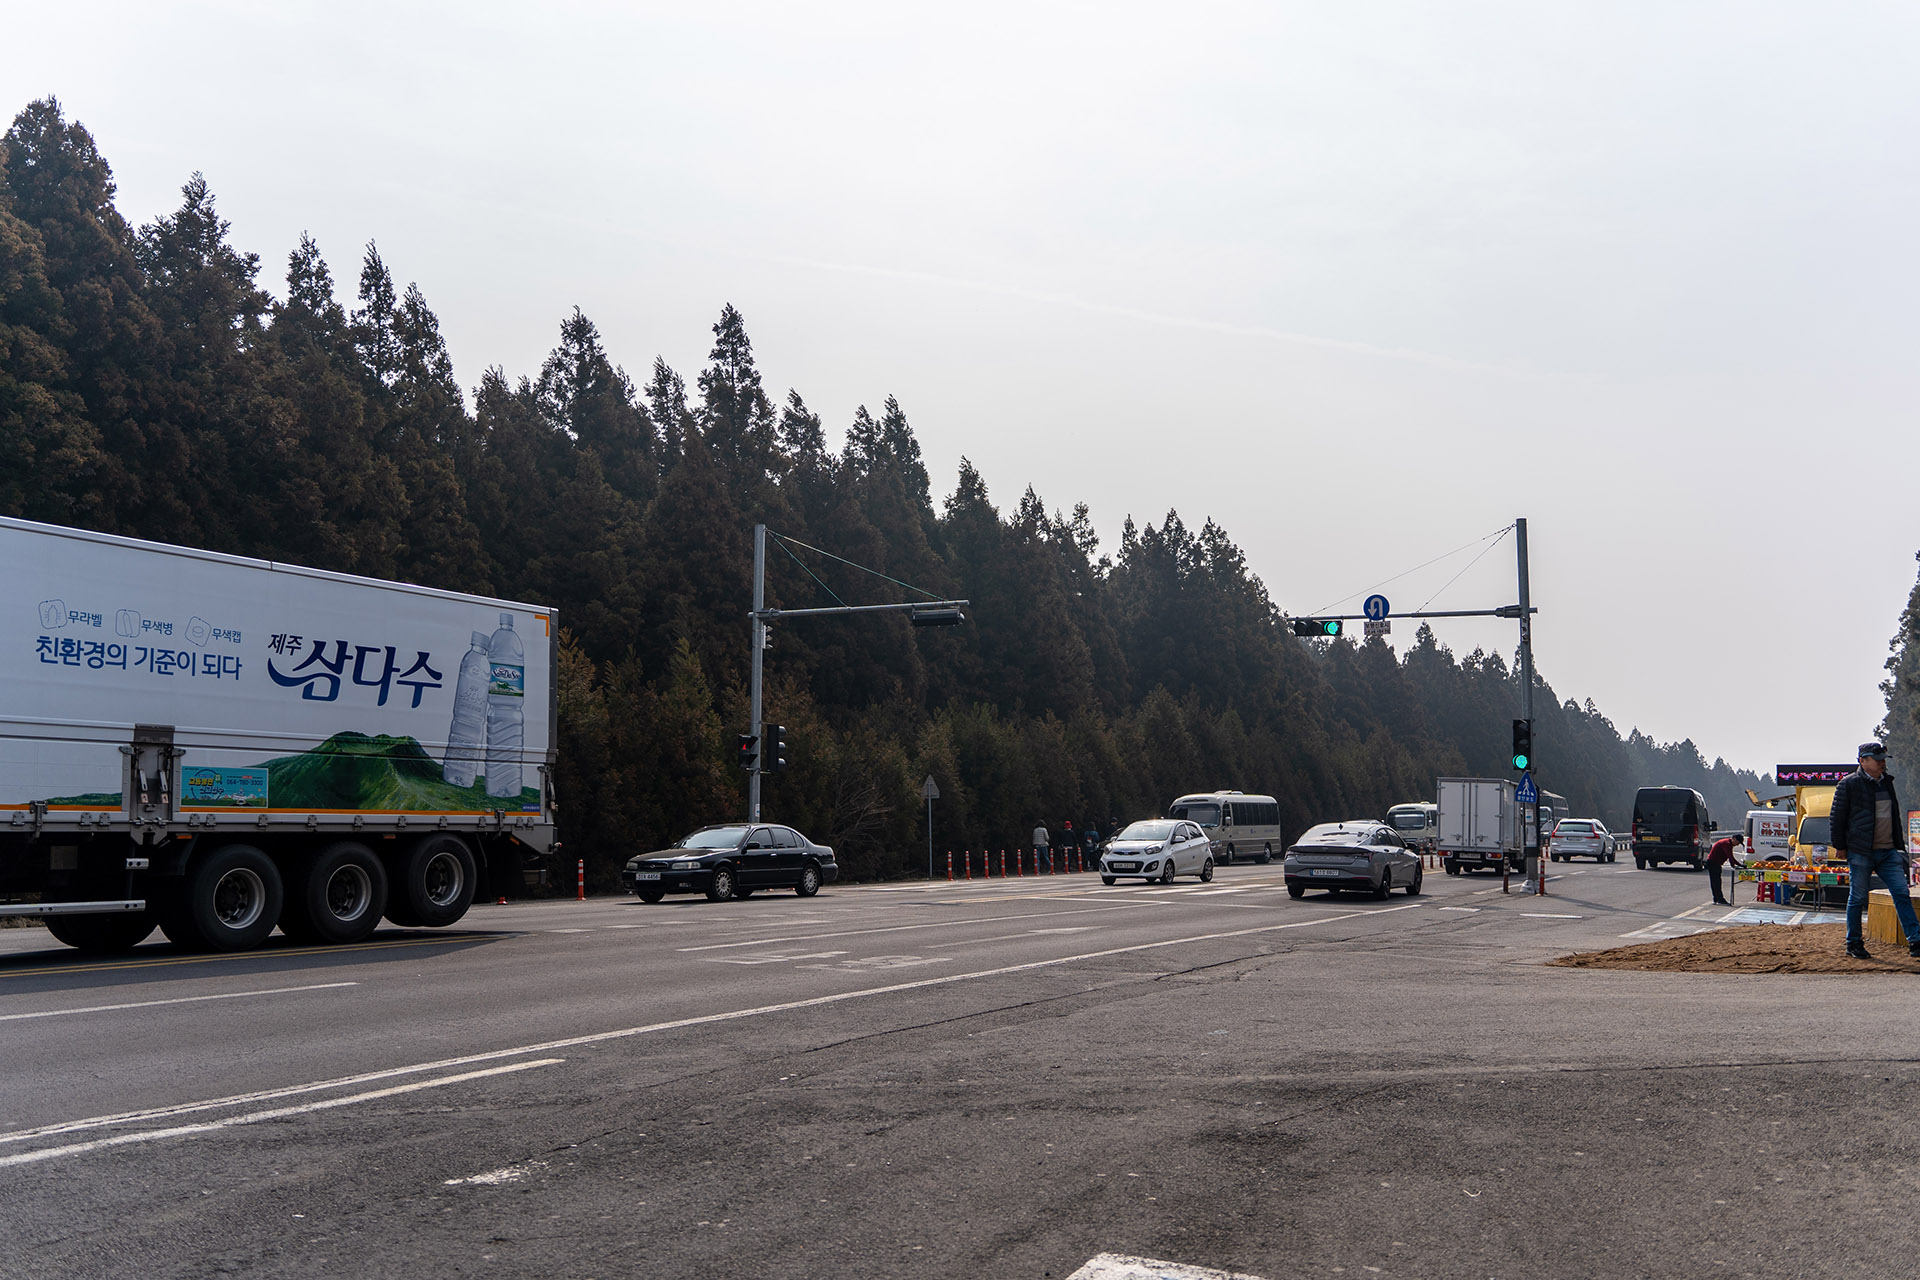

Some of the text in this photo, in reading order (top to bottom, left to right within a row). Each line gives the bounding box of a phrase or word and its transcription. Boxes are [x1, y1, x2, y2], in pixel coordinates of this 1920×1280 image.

[68, 610, 102, 628] 무라벨
[141, 619, 173, 636] 무색병
[212, 628, 241, 643] 무색캡
[267, 633, 303, 656] 제주
[35, 635, 243, 681] 친환경의 기준이 되다
[267, 640, 443, 709] 삼다수
